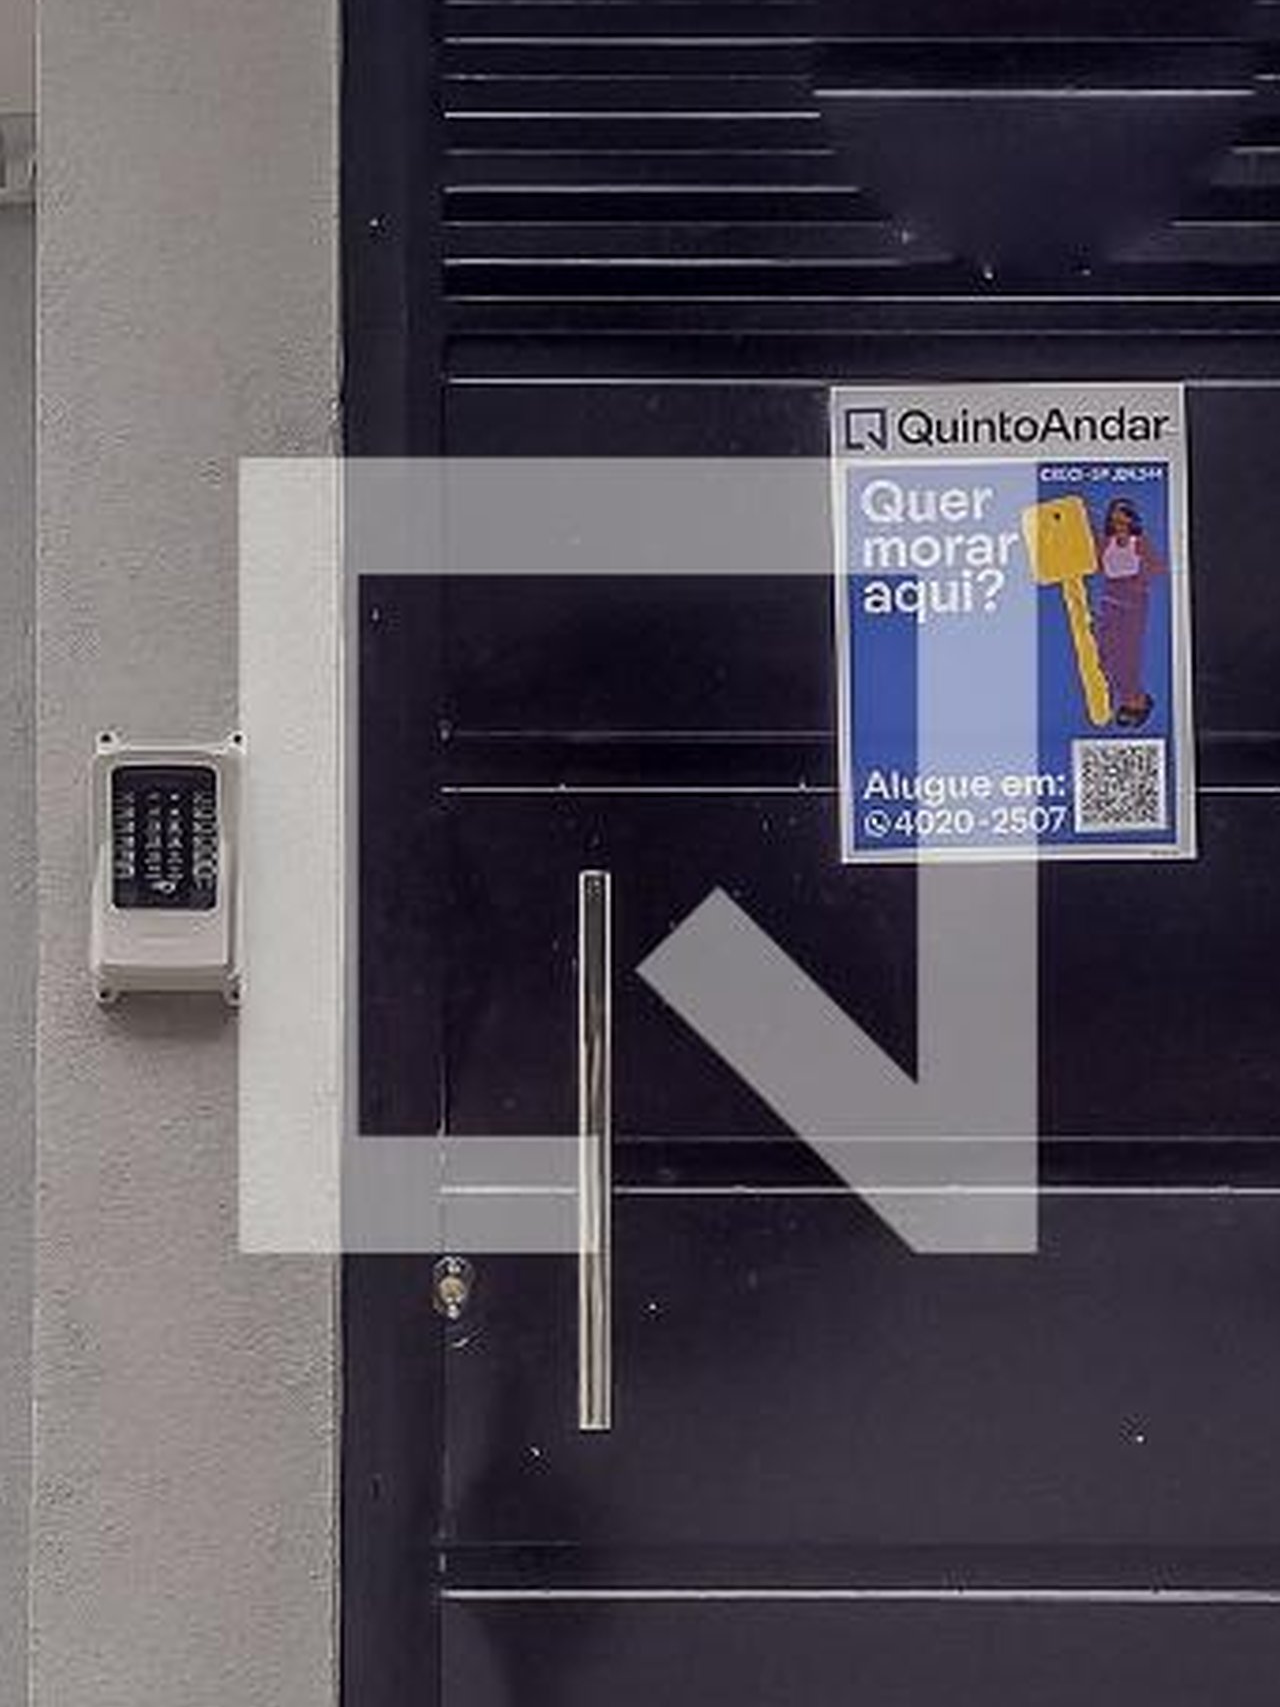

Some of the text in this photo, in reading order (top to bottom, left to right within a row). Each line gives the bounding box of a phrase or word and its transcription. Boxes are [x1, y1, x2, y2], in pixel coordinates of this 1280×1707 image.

[897, 407, 1170, 446] QuintoAndar
[862, 480, 993, 523] Quer
[862, 532, 1019, 568] morar
[862, 569, 1004, 624] aqui?
[862, 770, 1067, 805] Alugue em:
[893, 805, 1068, 837] 4020-2507
